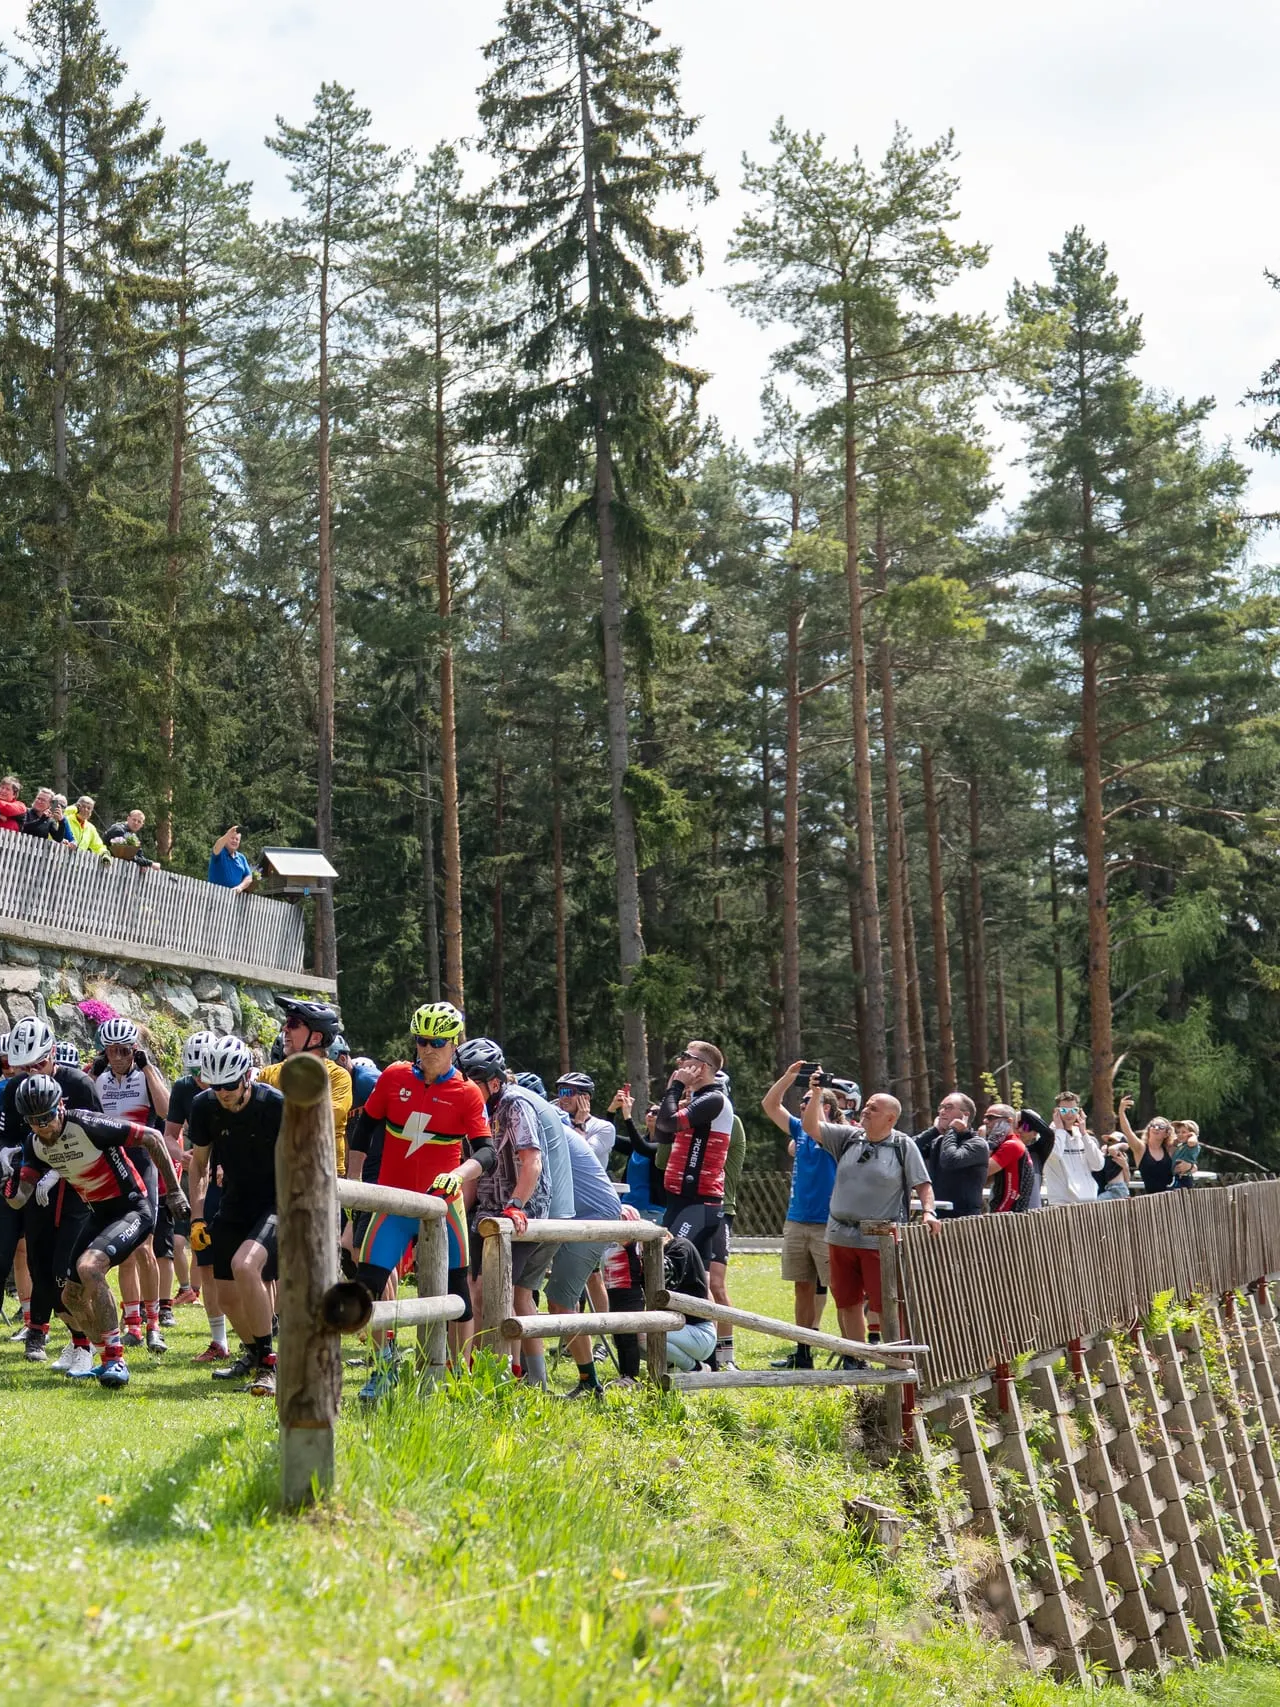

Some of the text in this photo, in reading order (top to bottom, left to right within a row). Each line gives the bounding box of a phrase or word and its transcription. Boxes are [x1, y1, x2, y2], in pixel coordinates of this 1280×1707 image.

[108, 1145, 129, 1180] PICHER
[689, 1138, 702, 1168] PICHER
[119, 1218, 141, 1242] PICHER
